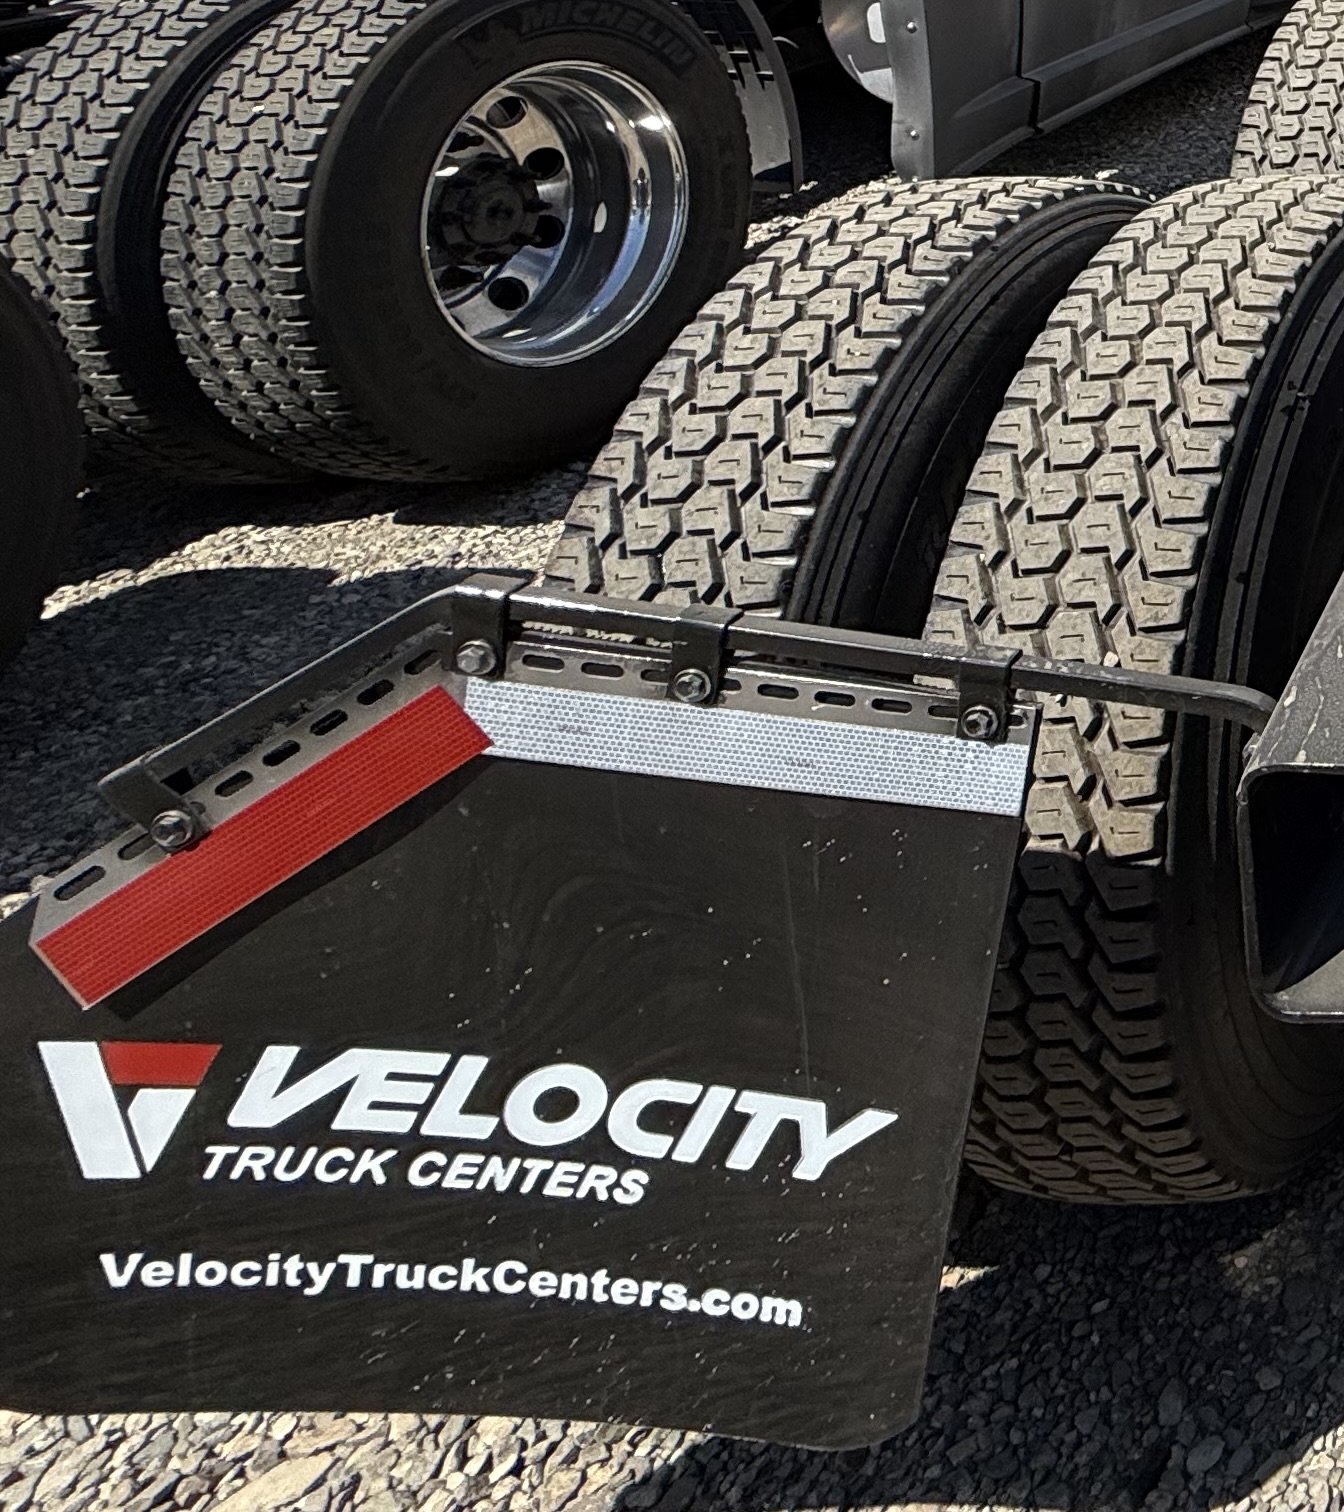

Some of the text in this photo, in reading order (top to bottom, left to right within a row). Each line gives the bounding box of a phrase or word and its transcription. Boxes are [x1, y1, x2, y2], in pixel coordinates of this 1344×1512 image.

[520, 0, 696, 68] MICHELIN
[227, 1044, 899, 1181] VELOCITY
[202, 1145, 650, 1204] TRUCK CENTERS
[100, 1252, 803, 1327] VelocityTruckCenters.com
